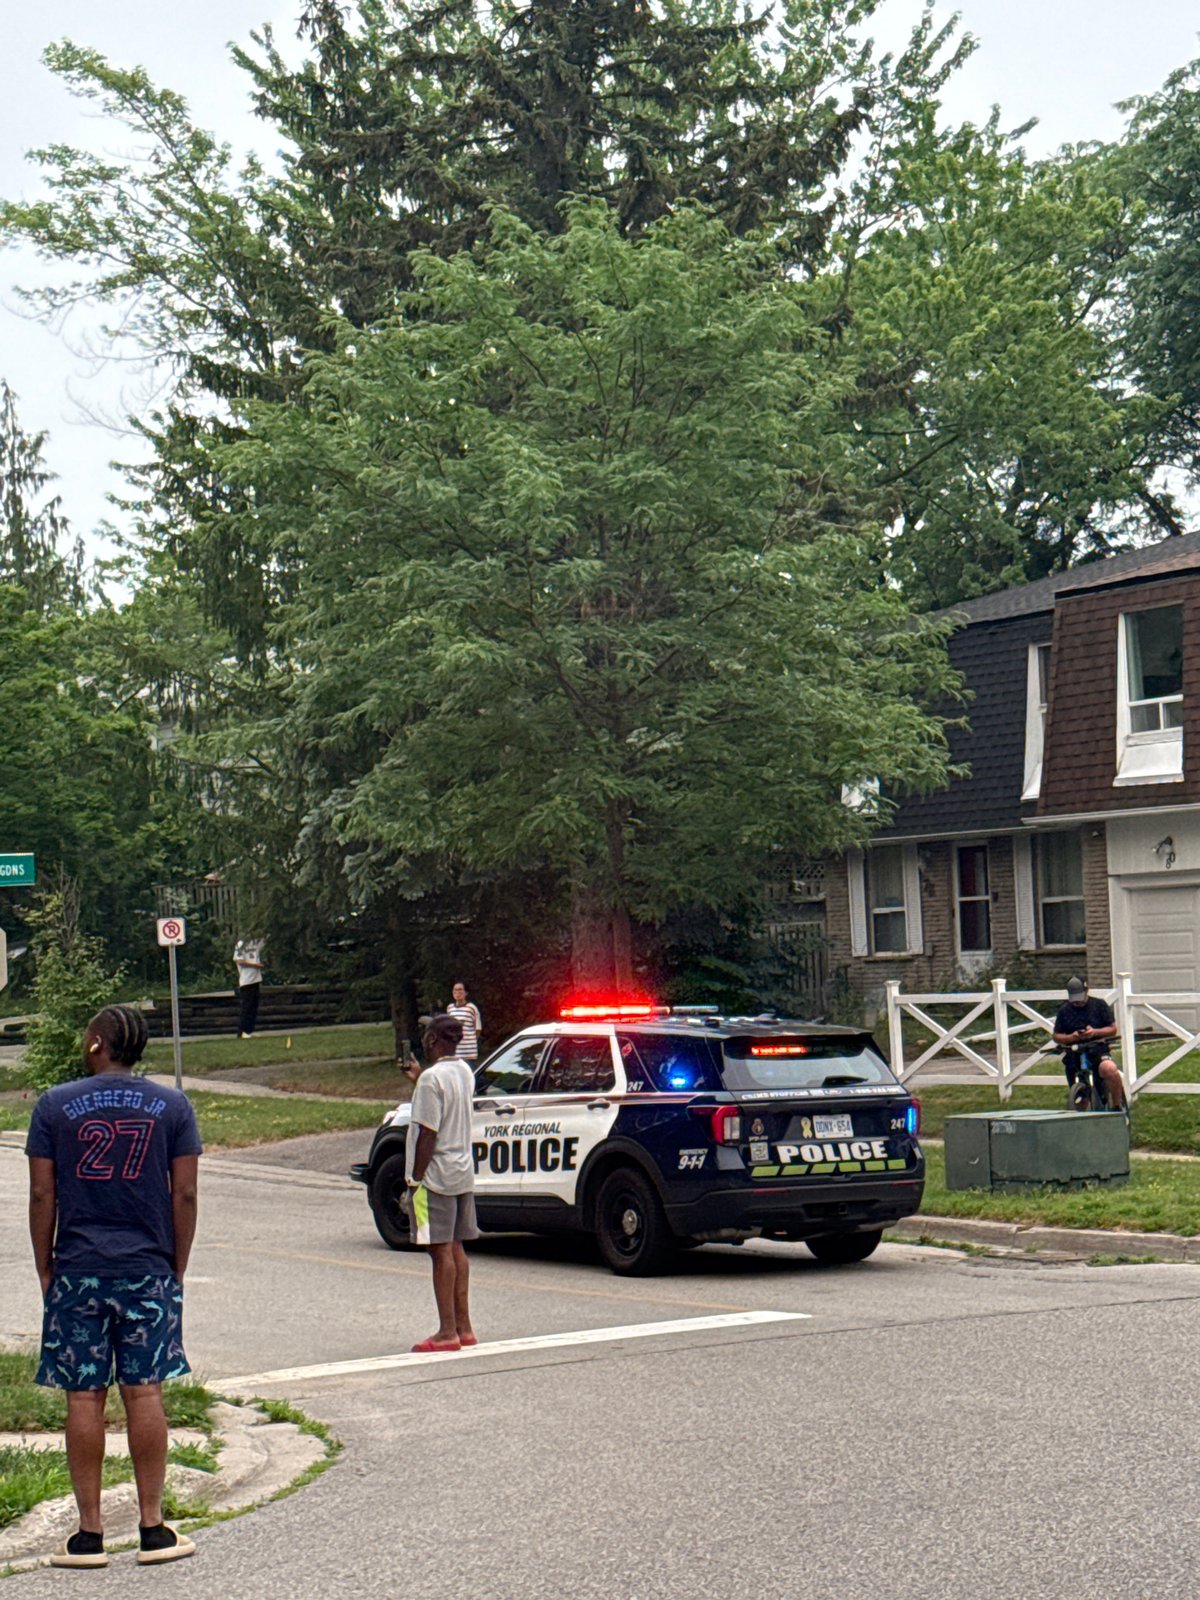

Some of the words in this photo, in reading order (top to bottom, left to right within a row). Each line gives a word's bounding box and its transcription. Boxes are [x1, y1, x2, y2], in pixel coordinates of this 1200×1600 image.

[0, 864, 25, 876] GDNS
[627, 1081, 644, 1091] 247
[62, 1089, 144, 1120] GUERRERO
[483, 1125, 511, 1138] YORK
[511, 1121, 562, 1136] REGIONAL
[890, 1118, 906, 1130] 247
[76, 1120, 155, 1180] 27
[471, 1137, 579, 1175] POLICE
[776, 1140, 888, 1164] POLICE
